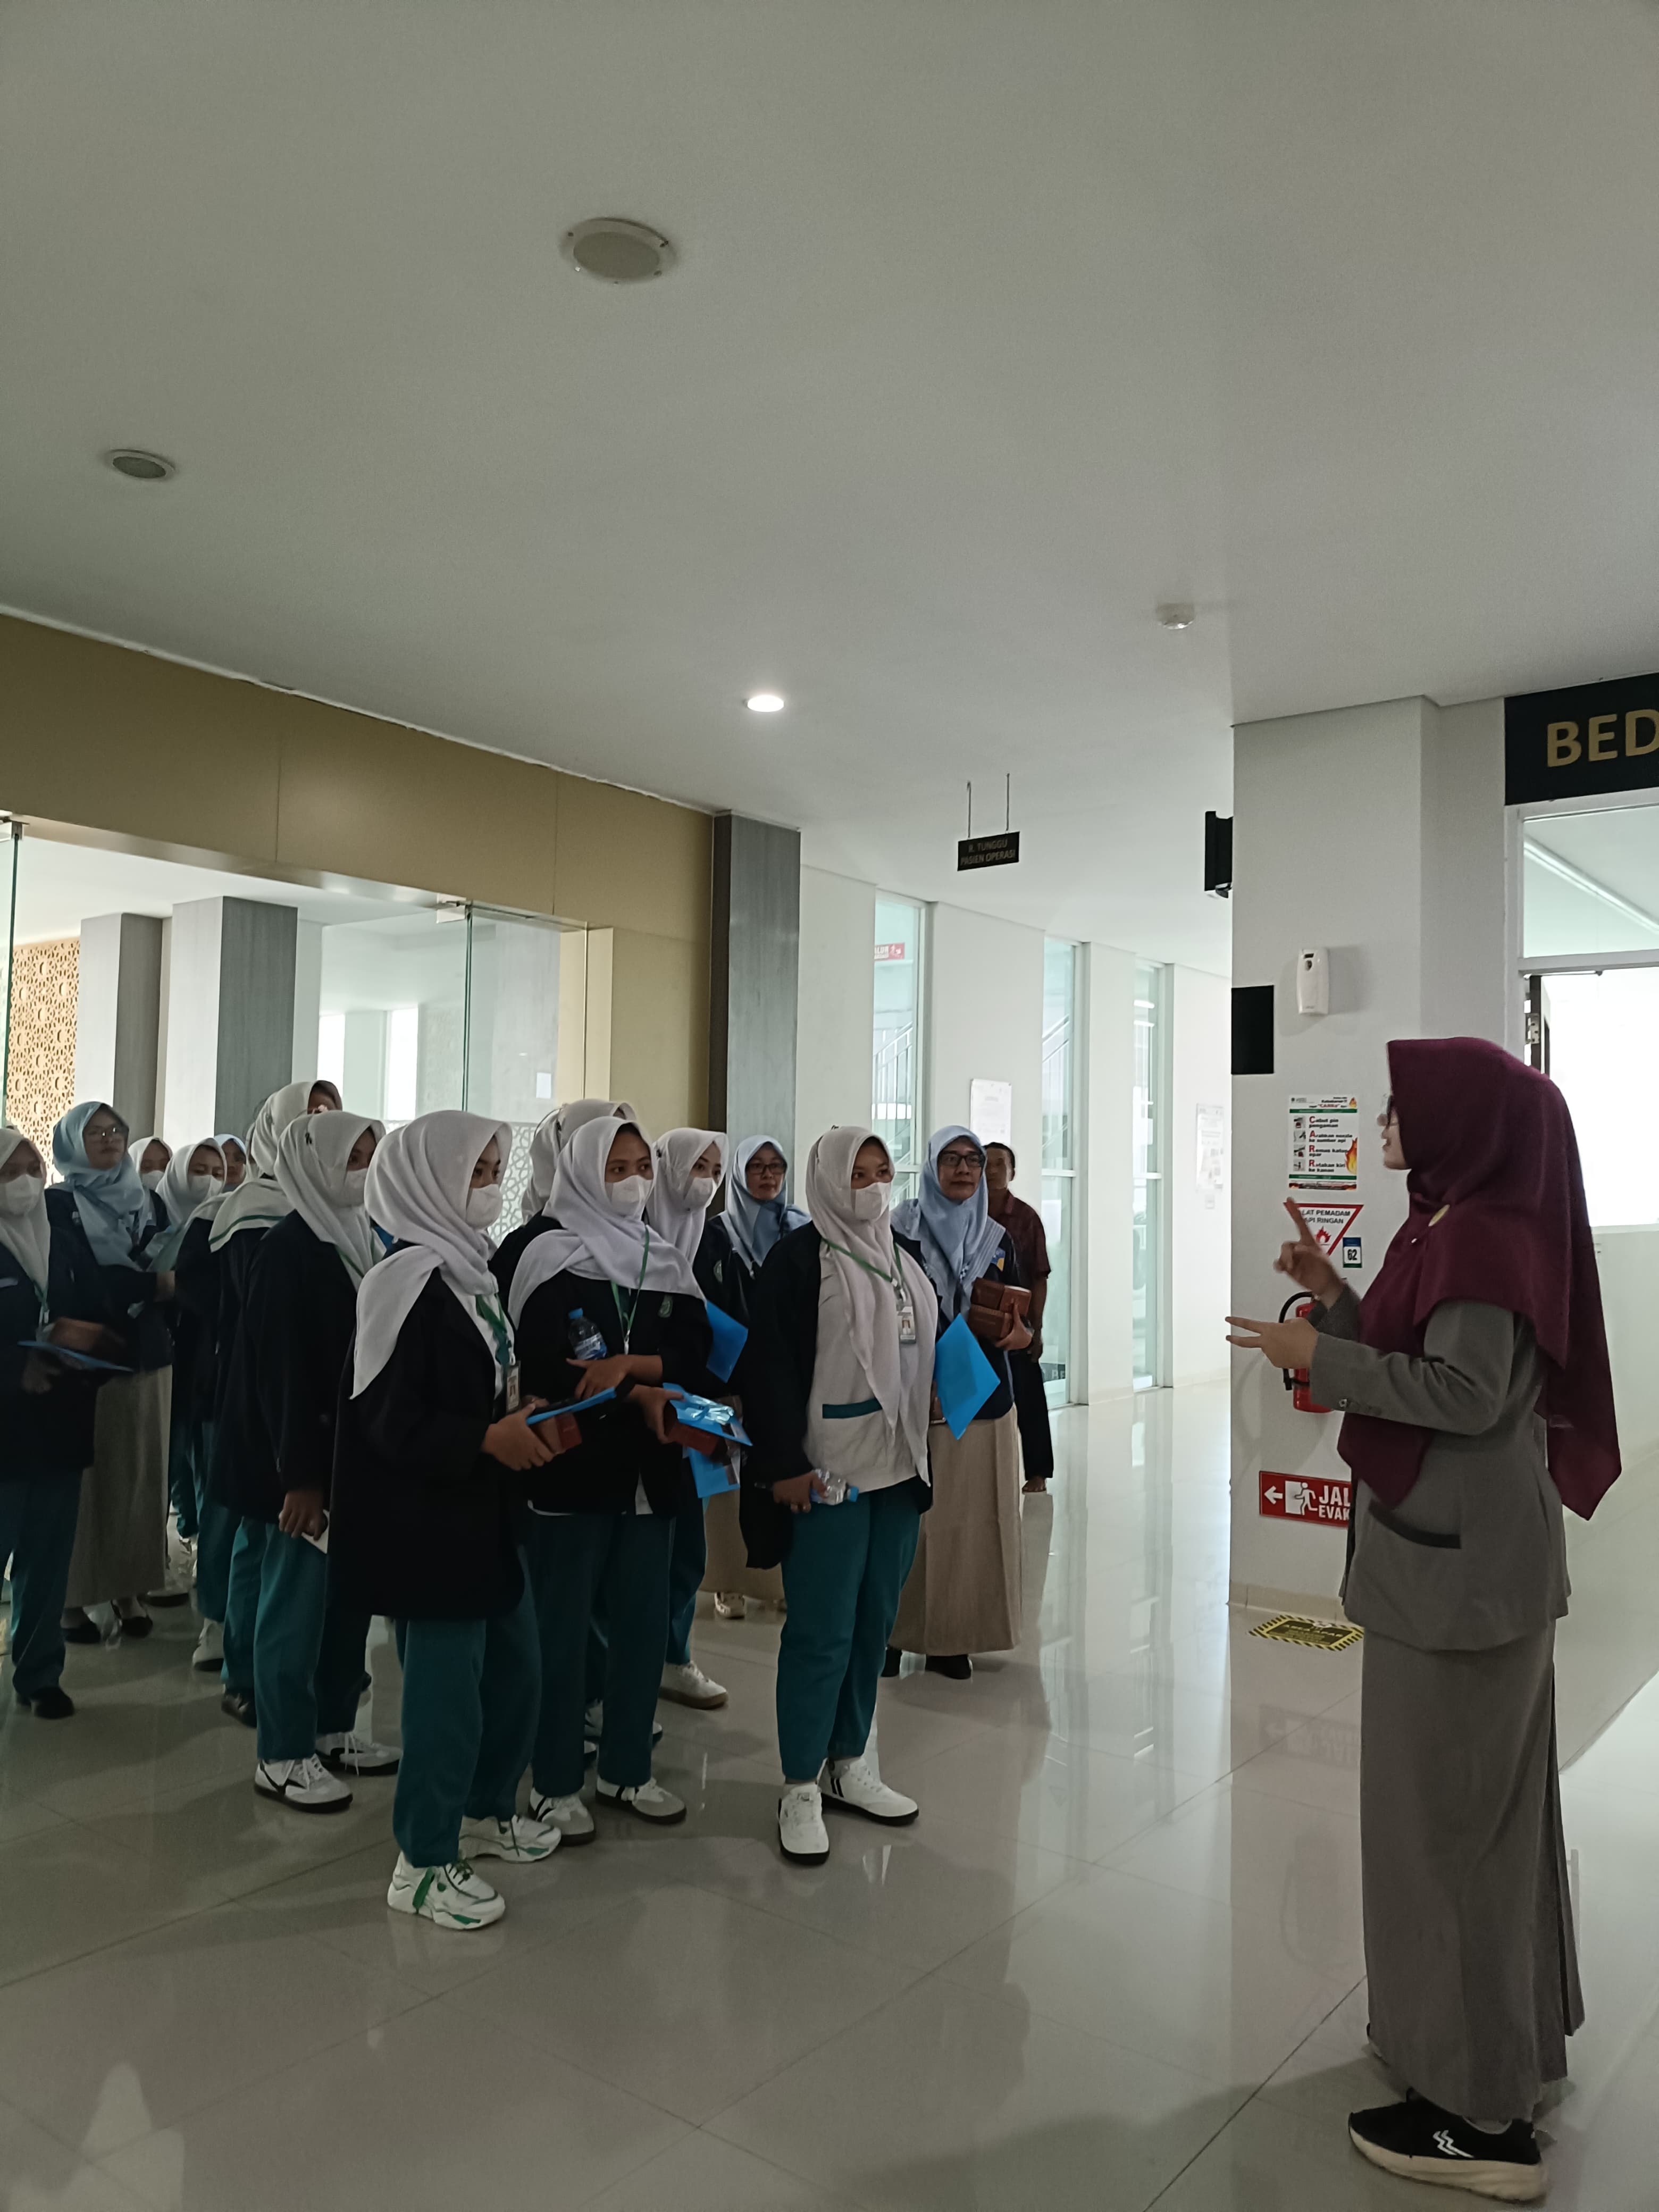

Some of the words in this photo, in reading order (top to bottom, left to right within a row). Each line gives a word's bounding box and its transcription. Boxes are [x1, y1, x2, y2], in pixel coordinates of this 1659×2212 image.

[1547, 709, 1659, 767] BED
[977, 839, 1008, 851] TUNGGU
[960, 854, 984, 866] PASIEN
[986, 849, 1016, 862] OPERASI
[1319, 1485, 1351, 1507] JAL
[1319, 1505, 1350, 1521] EVAK
